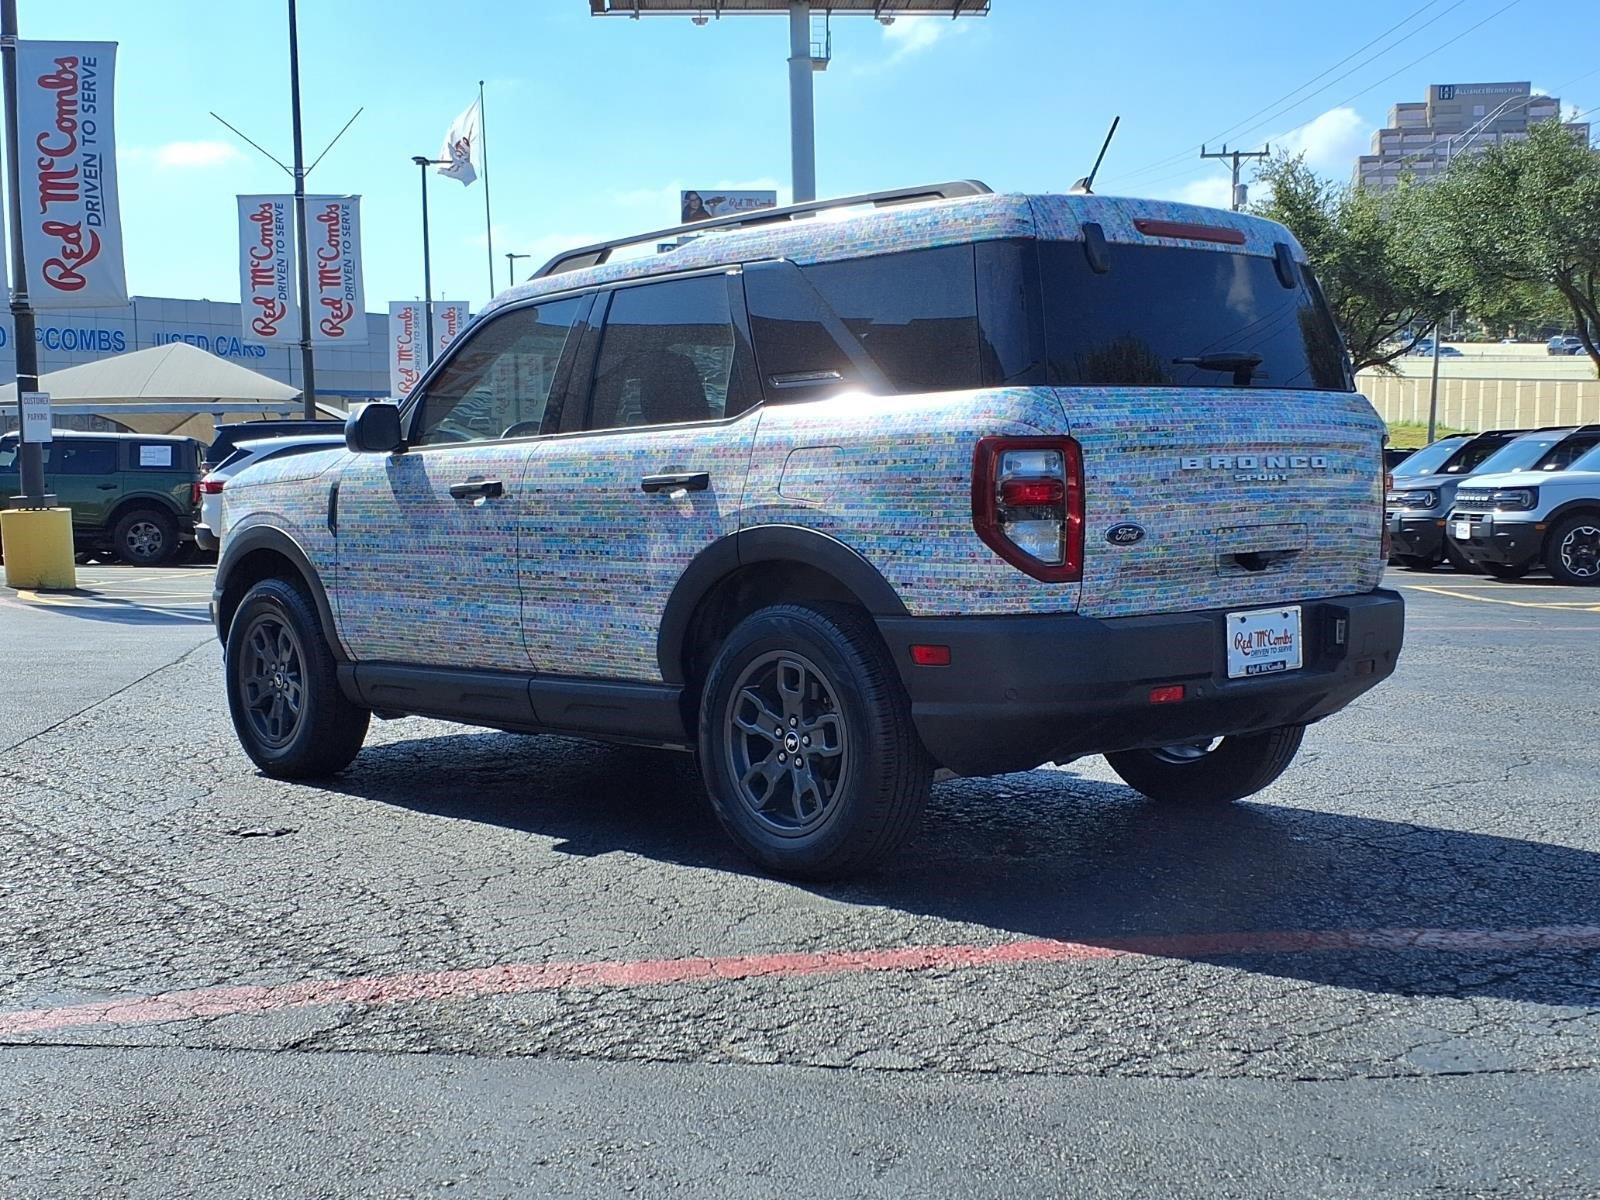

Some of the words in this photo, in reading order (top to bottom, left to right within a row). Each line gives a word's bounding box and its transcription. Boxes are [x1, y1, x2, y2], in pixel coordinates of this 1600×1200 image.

[82, 55, 97, 115] SERVE
[36, 55, 80, 215] McCombs
[82, 119, 97, 147] TO
[83, 152, 101, 227] DRIVEN
[275, 202, 285, 237] SERVE
[341, 204, 350, 237] SERVE
[42, 221, 101, 292] Red
[250, 202, 275, 293] McCombs
[276, 240, 285, 256] TO
[317, 203, 341, 293] McCombs
[342, 240, 352, 256] TO
[276, 259, 287, 300] DRIVEN
[343, 260, 353, 300] DRIVEN
[252, 296, 287, 337] Red
[320, 298, 354, 337] Red
[397, 306, 413, 365] McCombs
[441, 306, 456, 350] Combs
[398, 368, 420, 393] Red
[1181, 454, 1328, 471] BRONCO
[1233, 473, 1289, 482] SPORT
[1114, 527, 1139, 541] Ford
[1235, 632, 1252, 656] Red
[1254, 628, 1292, 647] McCombs
